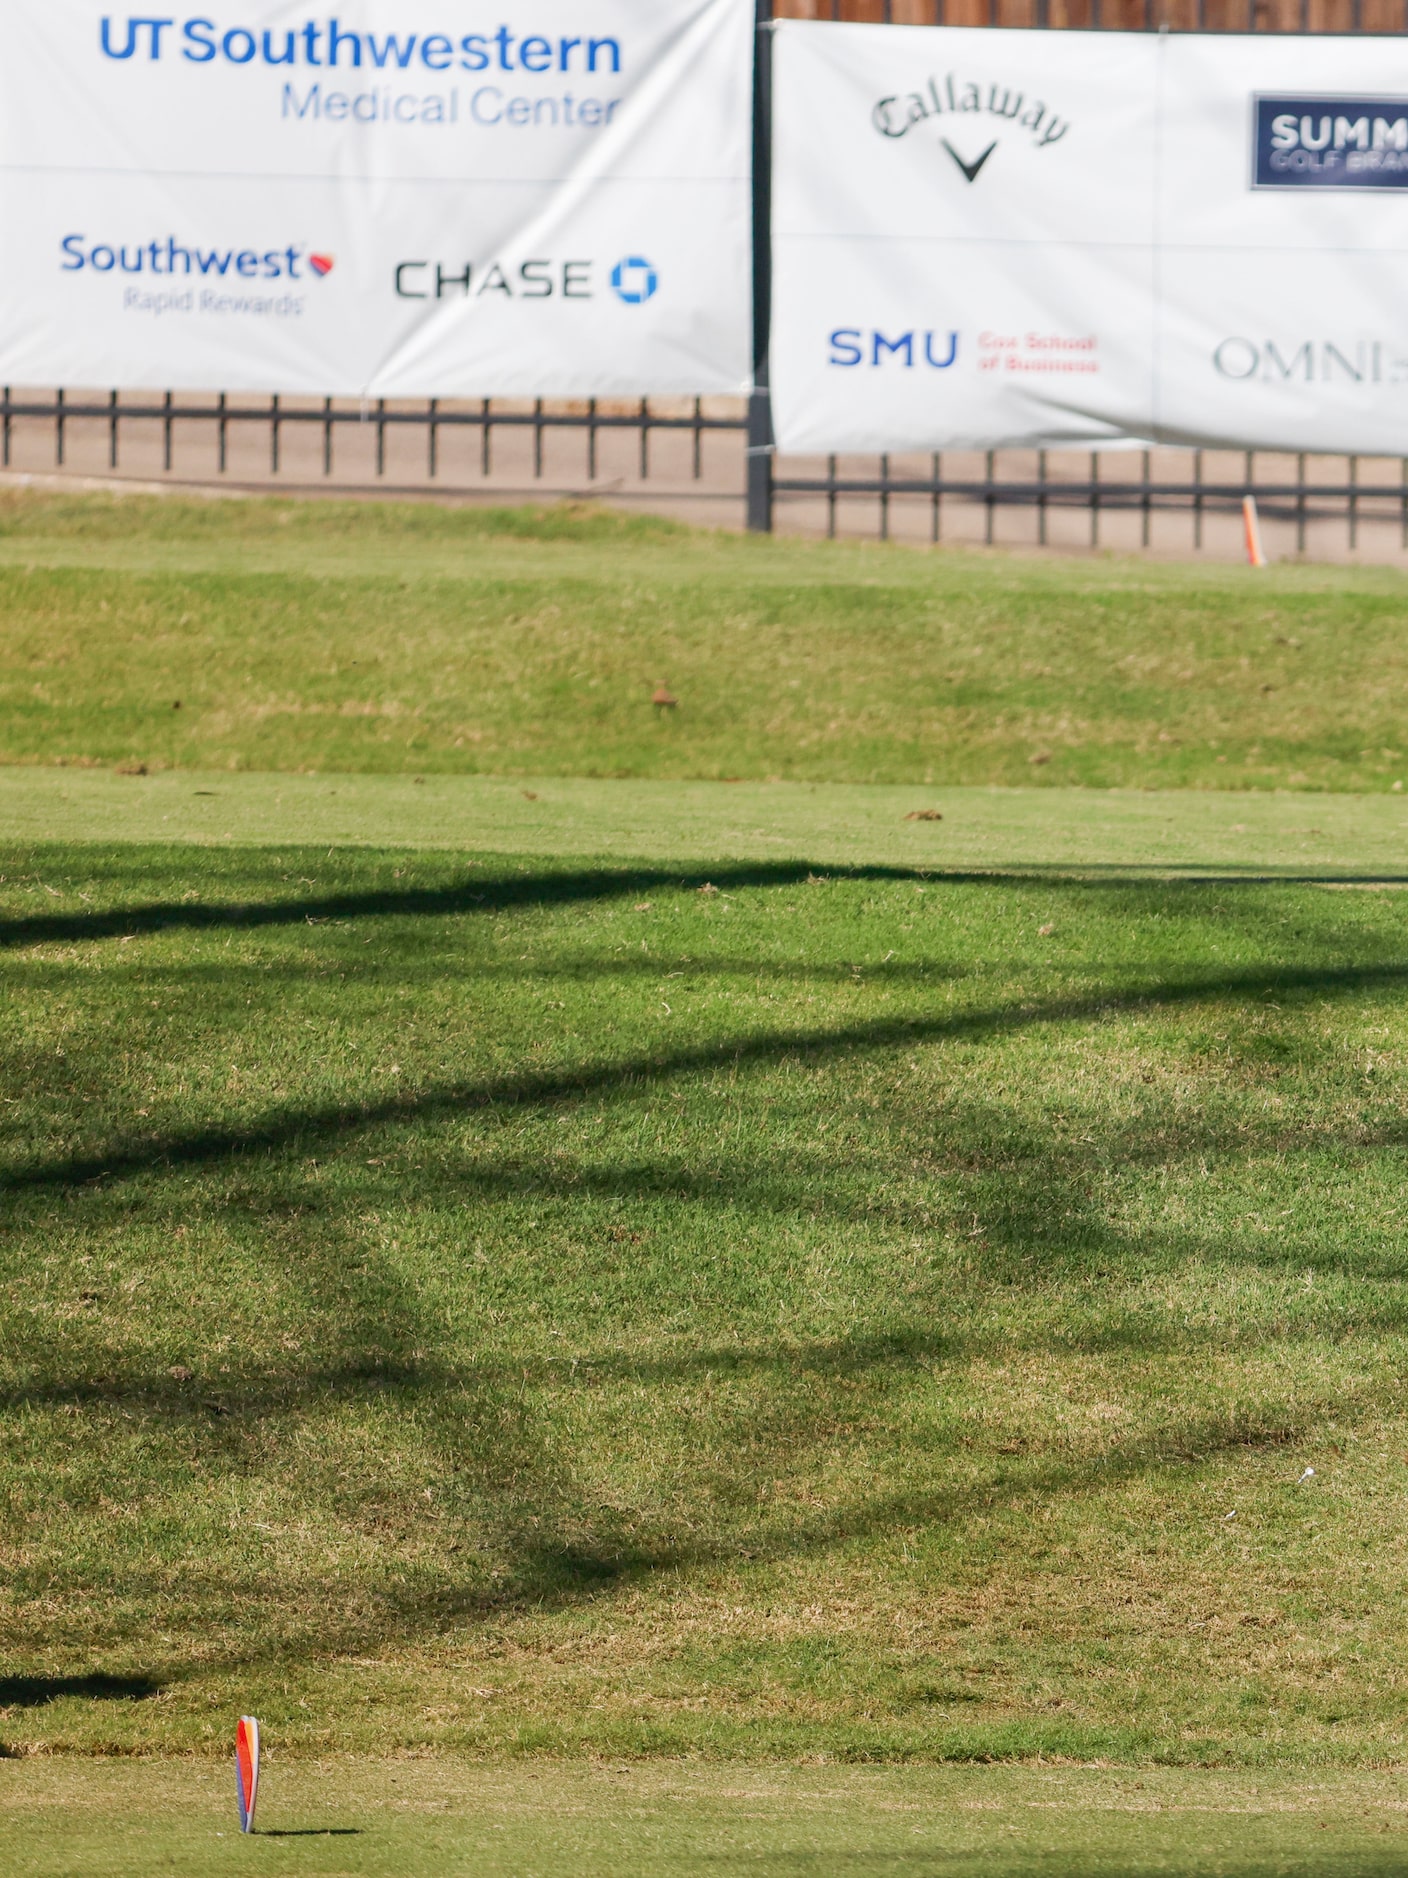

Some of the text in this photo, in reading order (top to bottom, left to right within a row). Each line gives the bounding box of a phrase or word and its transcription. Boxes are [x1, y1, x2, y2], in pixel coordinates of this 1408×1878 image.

[100, 16, 621, 72] UT Southwestern
[281, 82, 620, 127] Medical Center
[872, 72, 1069, 146] Callaway
[1269, 150, 1344, 174] GOLF
[61, 234, 302, 278] Southwest
[395, 259, 595, 300] CHASE
[124, 287, 305, 316] Rapid Rewards
[829, 328, 958, 368] SMU
[1025, 331, 1097, 351] School
[1213, 336, 1382, 383] OMNI
[1006, 355, 1100, 373] Business
